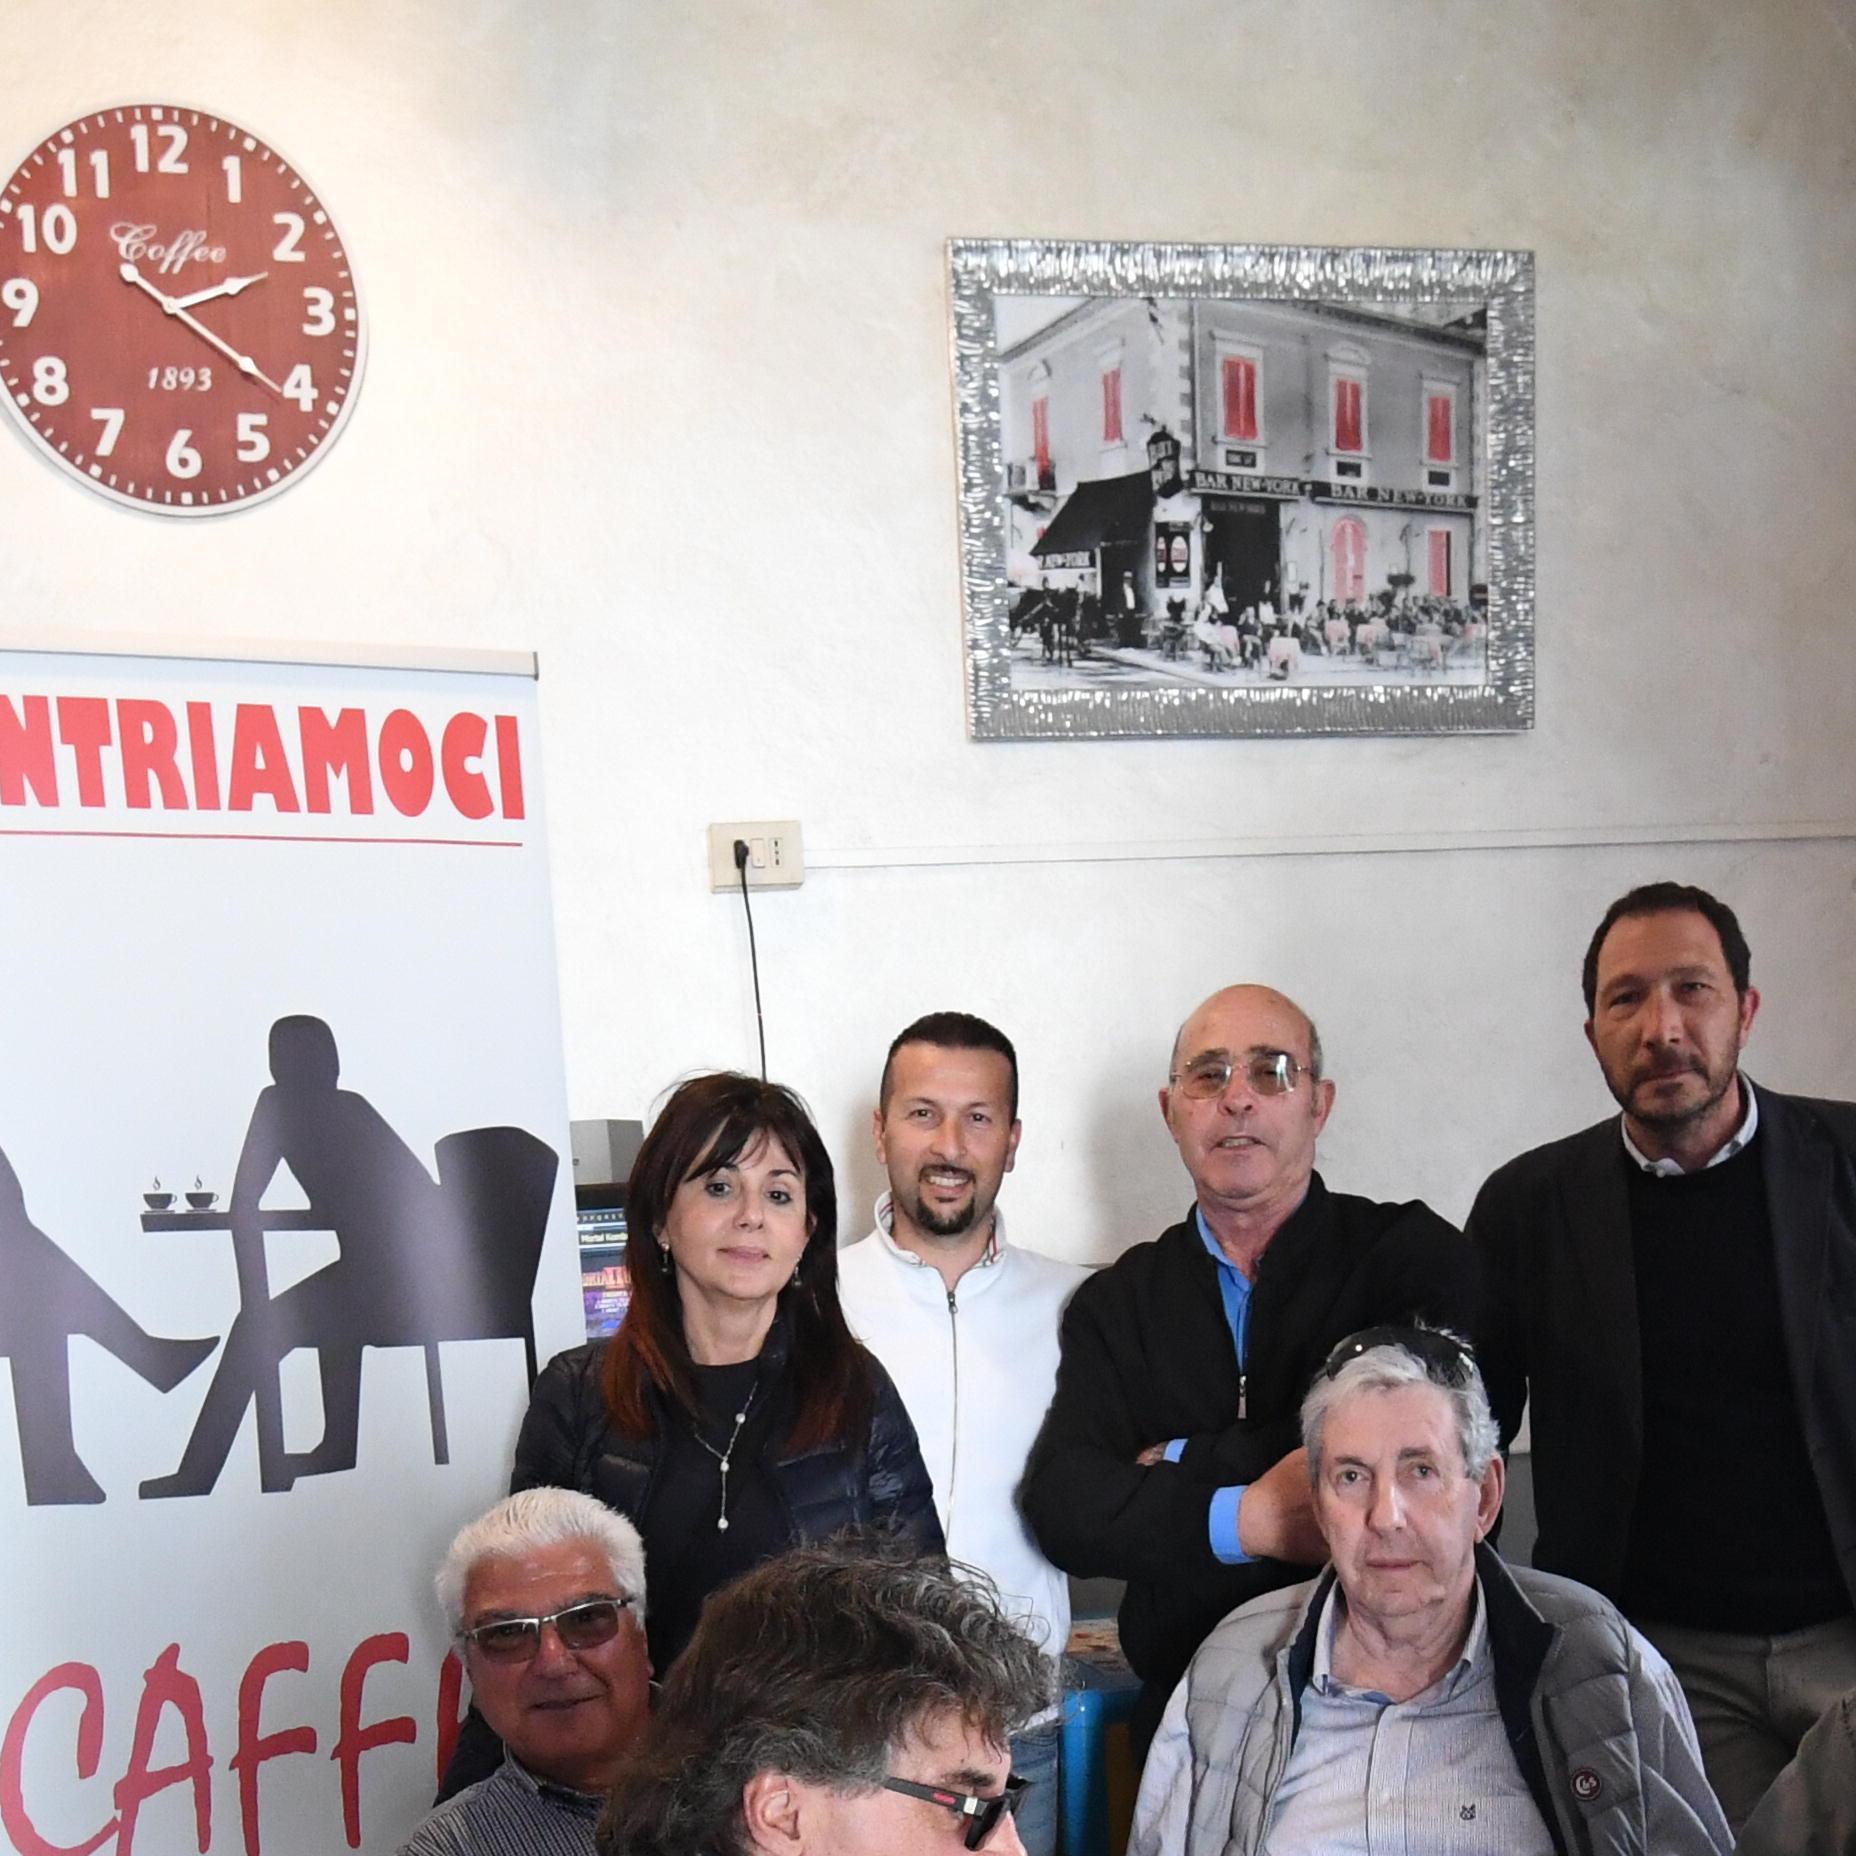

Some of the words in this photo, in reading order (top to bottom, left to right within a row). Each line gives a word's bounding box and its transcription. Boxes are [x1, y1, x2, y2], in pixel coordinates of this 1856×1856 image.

[58, 148, 110, 199] 11
[131, 124, 189, 174] 12
[222, 154, 242, 203] 1
[17, 203, 78, 255] 10
[110, 221, 227, 275] Coffee
[272, 211, 306, 262] 2
[2, 277, 39, 328] 9
[302, 286, 336, 337] 3
[32, 355, 70, 406] 8
[148, 366, 213, 392] 1893
[283, 364, 318, 412] 4
[90, 407, 125, 457] 7
[165, 429, 203, 480] 6
[237, 412, 271, 463] 5
[1195, 471, 1229, 490] BAR
[1330, 483, 1369, 501] BAR
